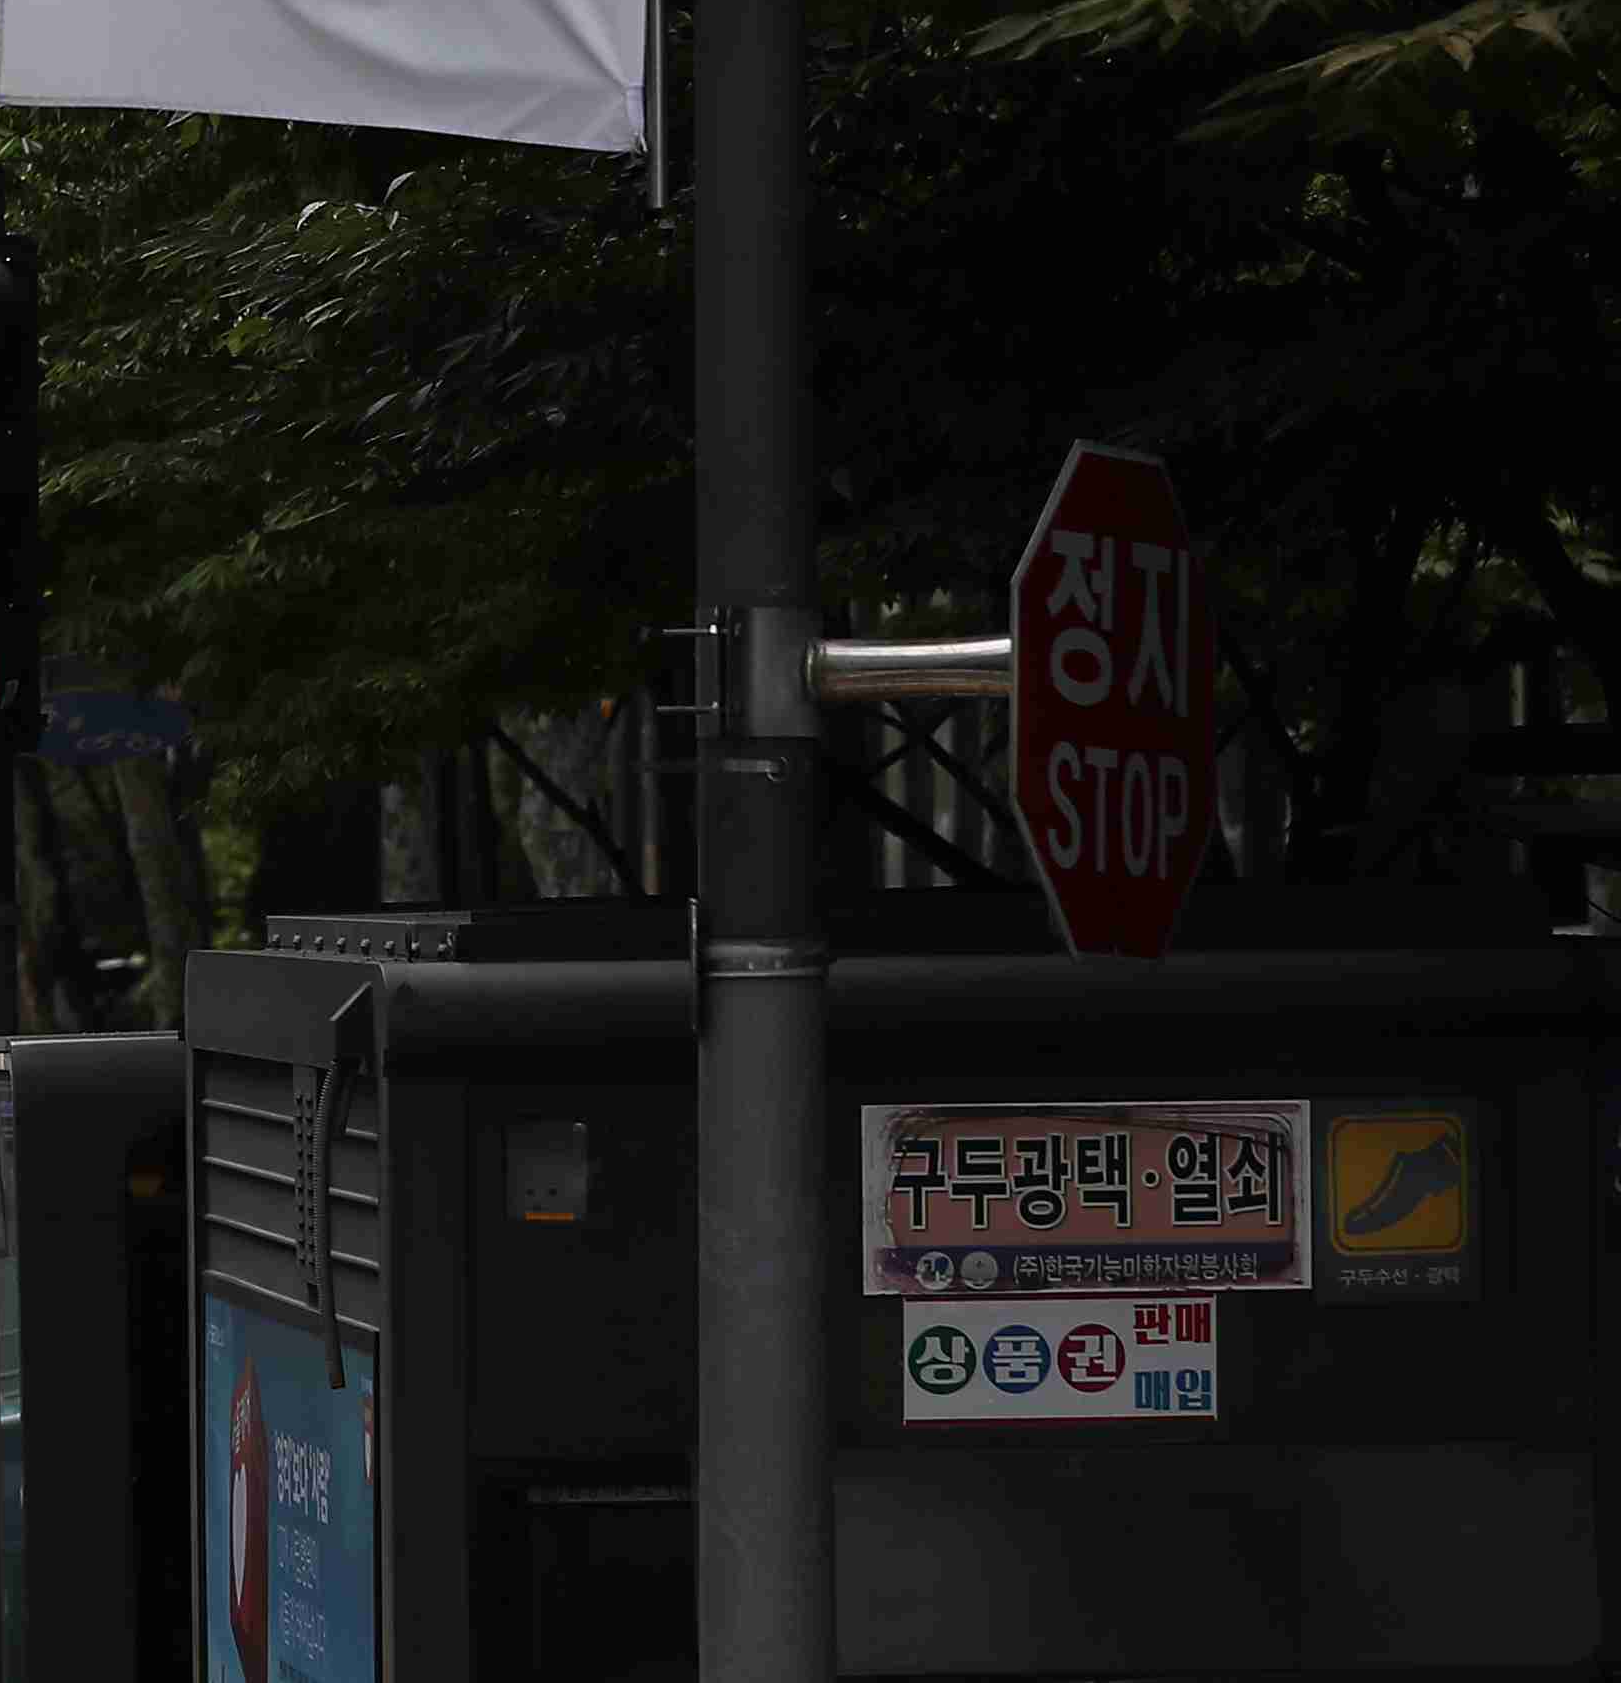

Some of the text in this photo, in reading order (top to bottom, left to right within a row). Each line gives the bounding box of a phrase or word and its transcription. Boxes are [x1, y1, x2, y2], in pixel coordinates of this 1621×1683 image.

[1046, 528, 1189, 719] 정지
[1047, 739, 1190, 880] STOP
[1133, 1302, 1213, 1346] 판매
[917, 1328, 1118, 1387] 상품권
[1134, 1368, 1213, 1412] 매입
